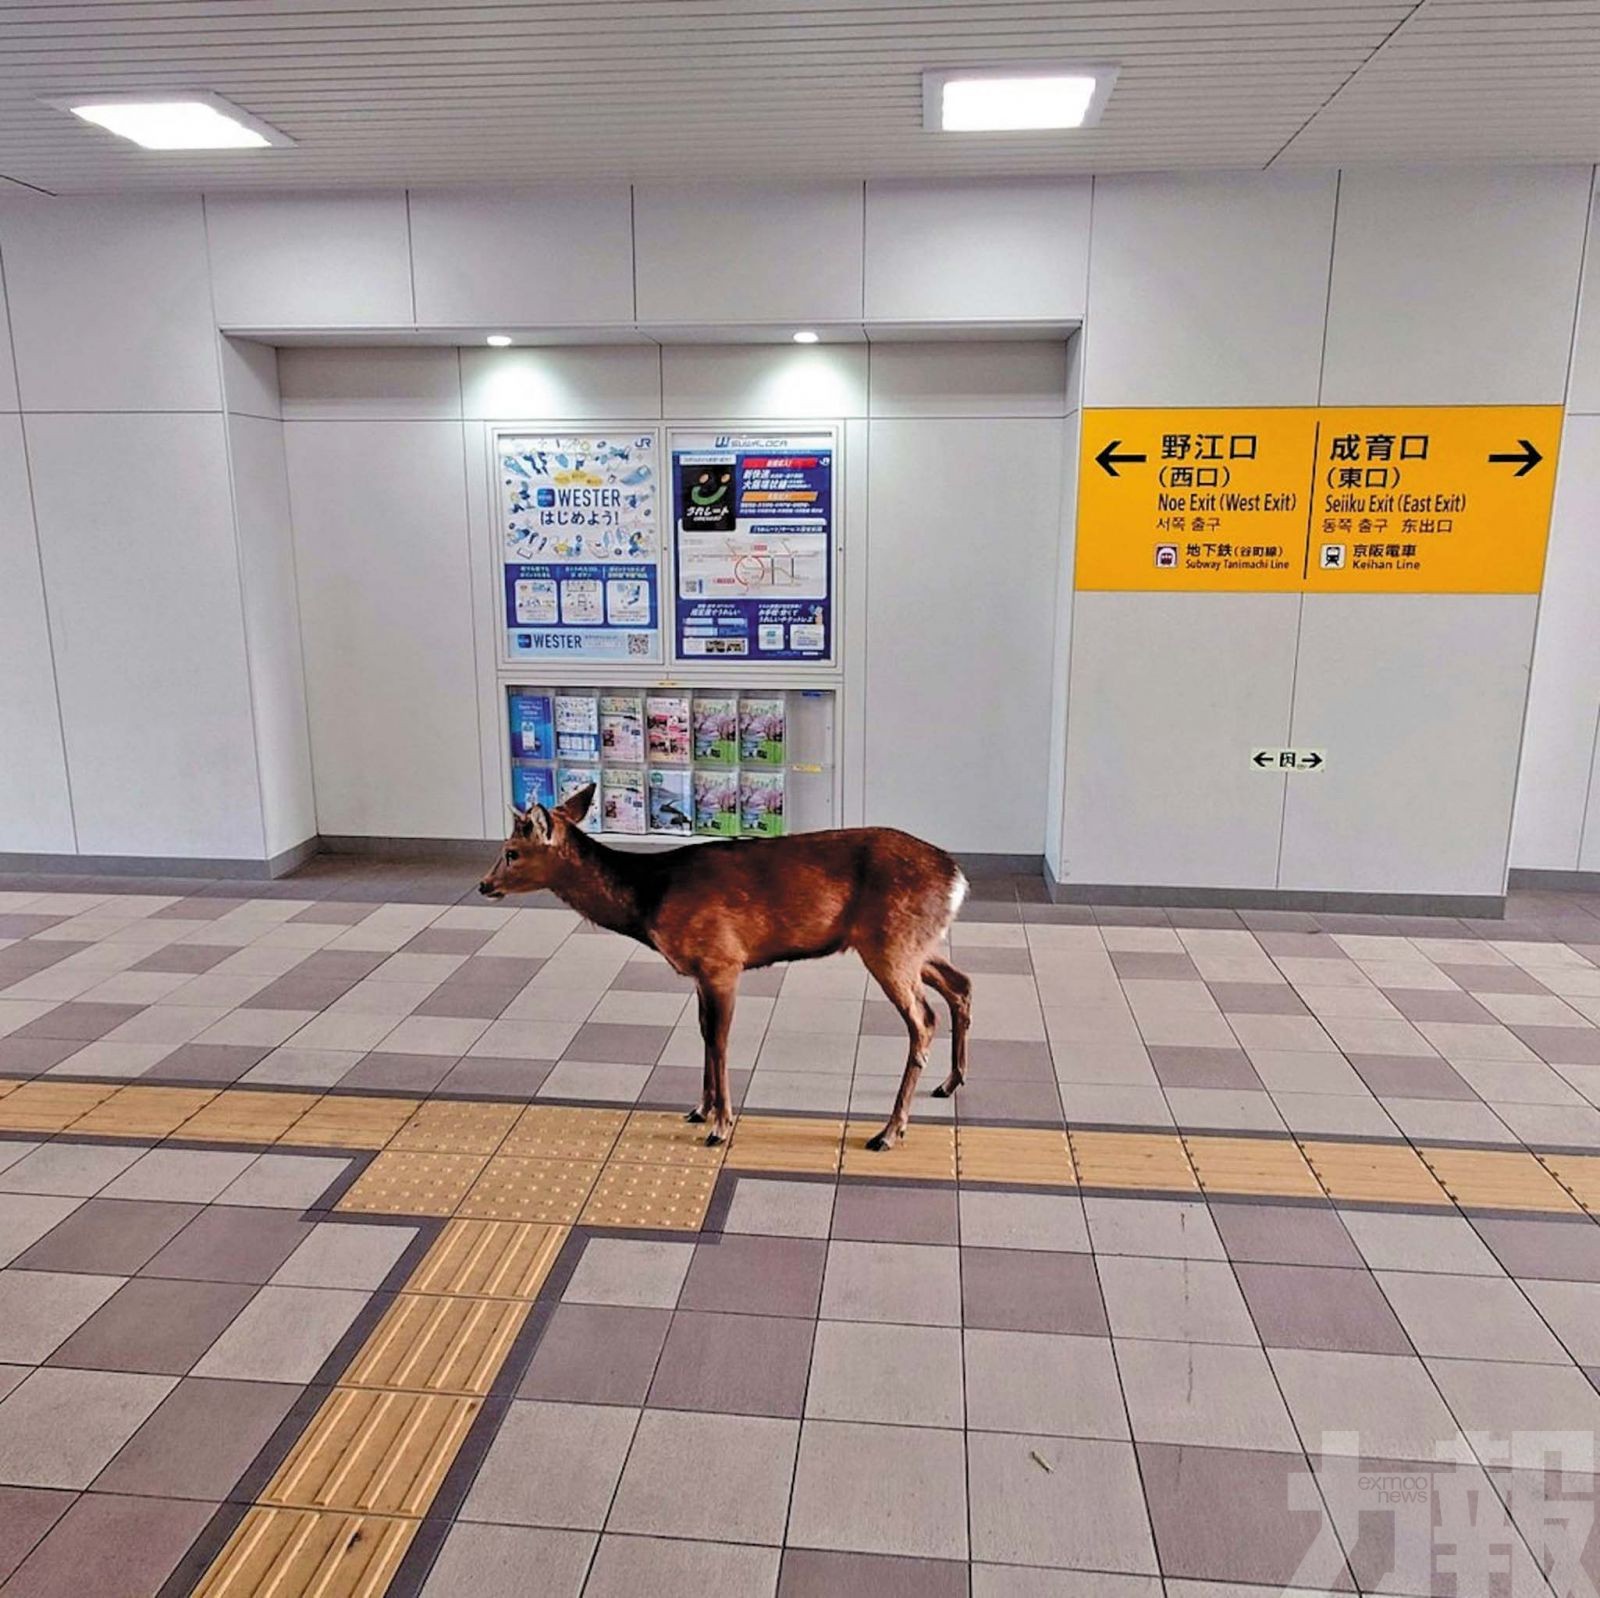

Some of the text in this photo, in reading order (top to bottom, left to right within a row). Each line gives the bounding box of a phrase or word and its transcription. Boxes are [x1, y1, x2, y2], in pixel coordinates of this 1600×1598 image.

[635, 438, 651, 448] JR
[1161, 434, 1257, 460] 野江口
[1330, 434, 1429, 461] 成育口
[1159, 466, 1230, 488] （西口）
[1327, 467, 1401, 489] （東口）
[558, 488, 621, 507] WESTER
[1158, 493, 1297, 512] Noe Exit (West Exit)
[1325, 494, 1466, 513] Seiiku Exit (East Exit)
[540, 510, 619, 526] はじめよう！
[1157, 516, 1220, 531] 서쪽 출구
[1322, 518, 1388, 533] 동쪽 출구
[1402, 518, 1453, 533] 东出口
[1353, 544, 1417, 558] 京阪電車
[1186, 559, 1290, 571] Subway Tanimachi Line
[1353, 559, 1420, 570] Keihan Line
[533, 634, 583, 649] WESTER
